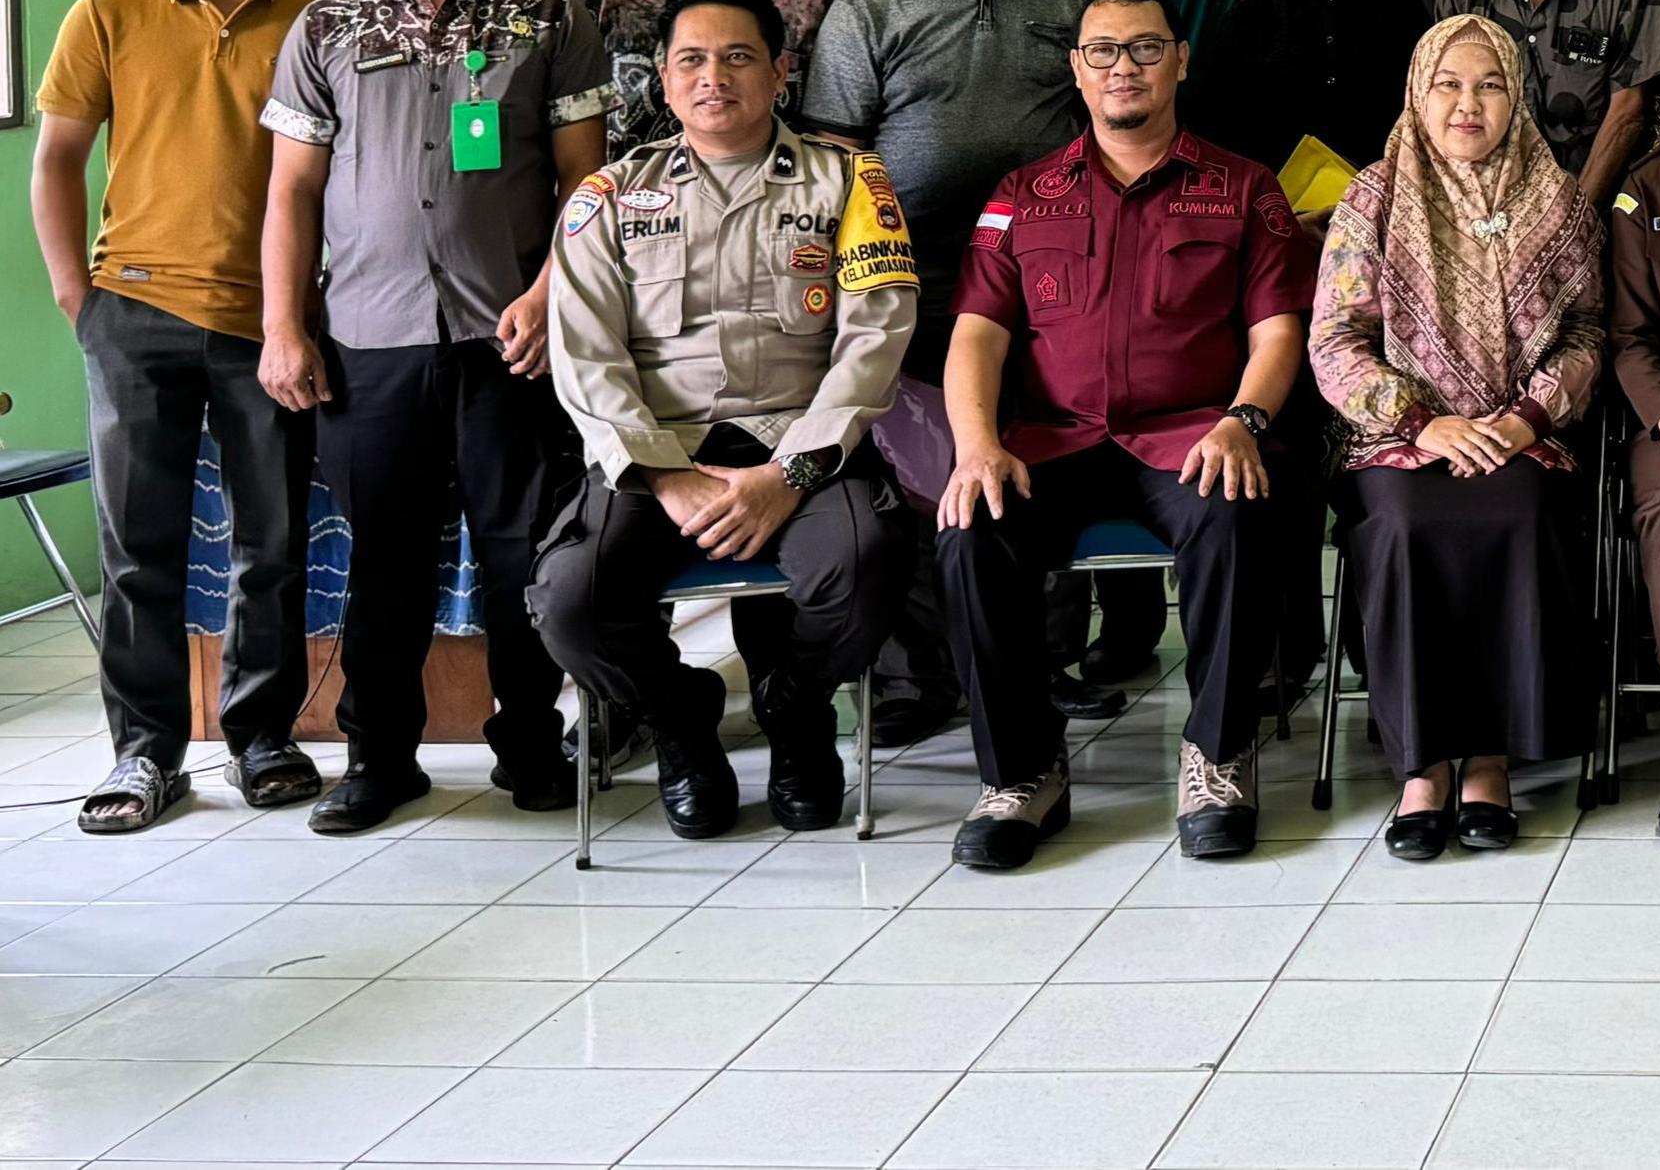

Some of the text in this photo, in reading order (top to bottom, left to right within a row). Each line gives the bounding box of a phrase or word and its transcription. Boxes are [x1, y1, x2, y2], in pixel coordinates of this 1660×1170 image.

[1020, 203, 1086, 221] YULLI
[1169, 202, 1236, 216] KUMHAM
[618, 216, 681, 242] ERU.M
